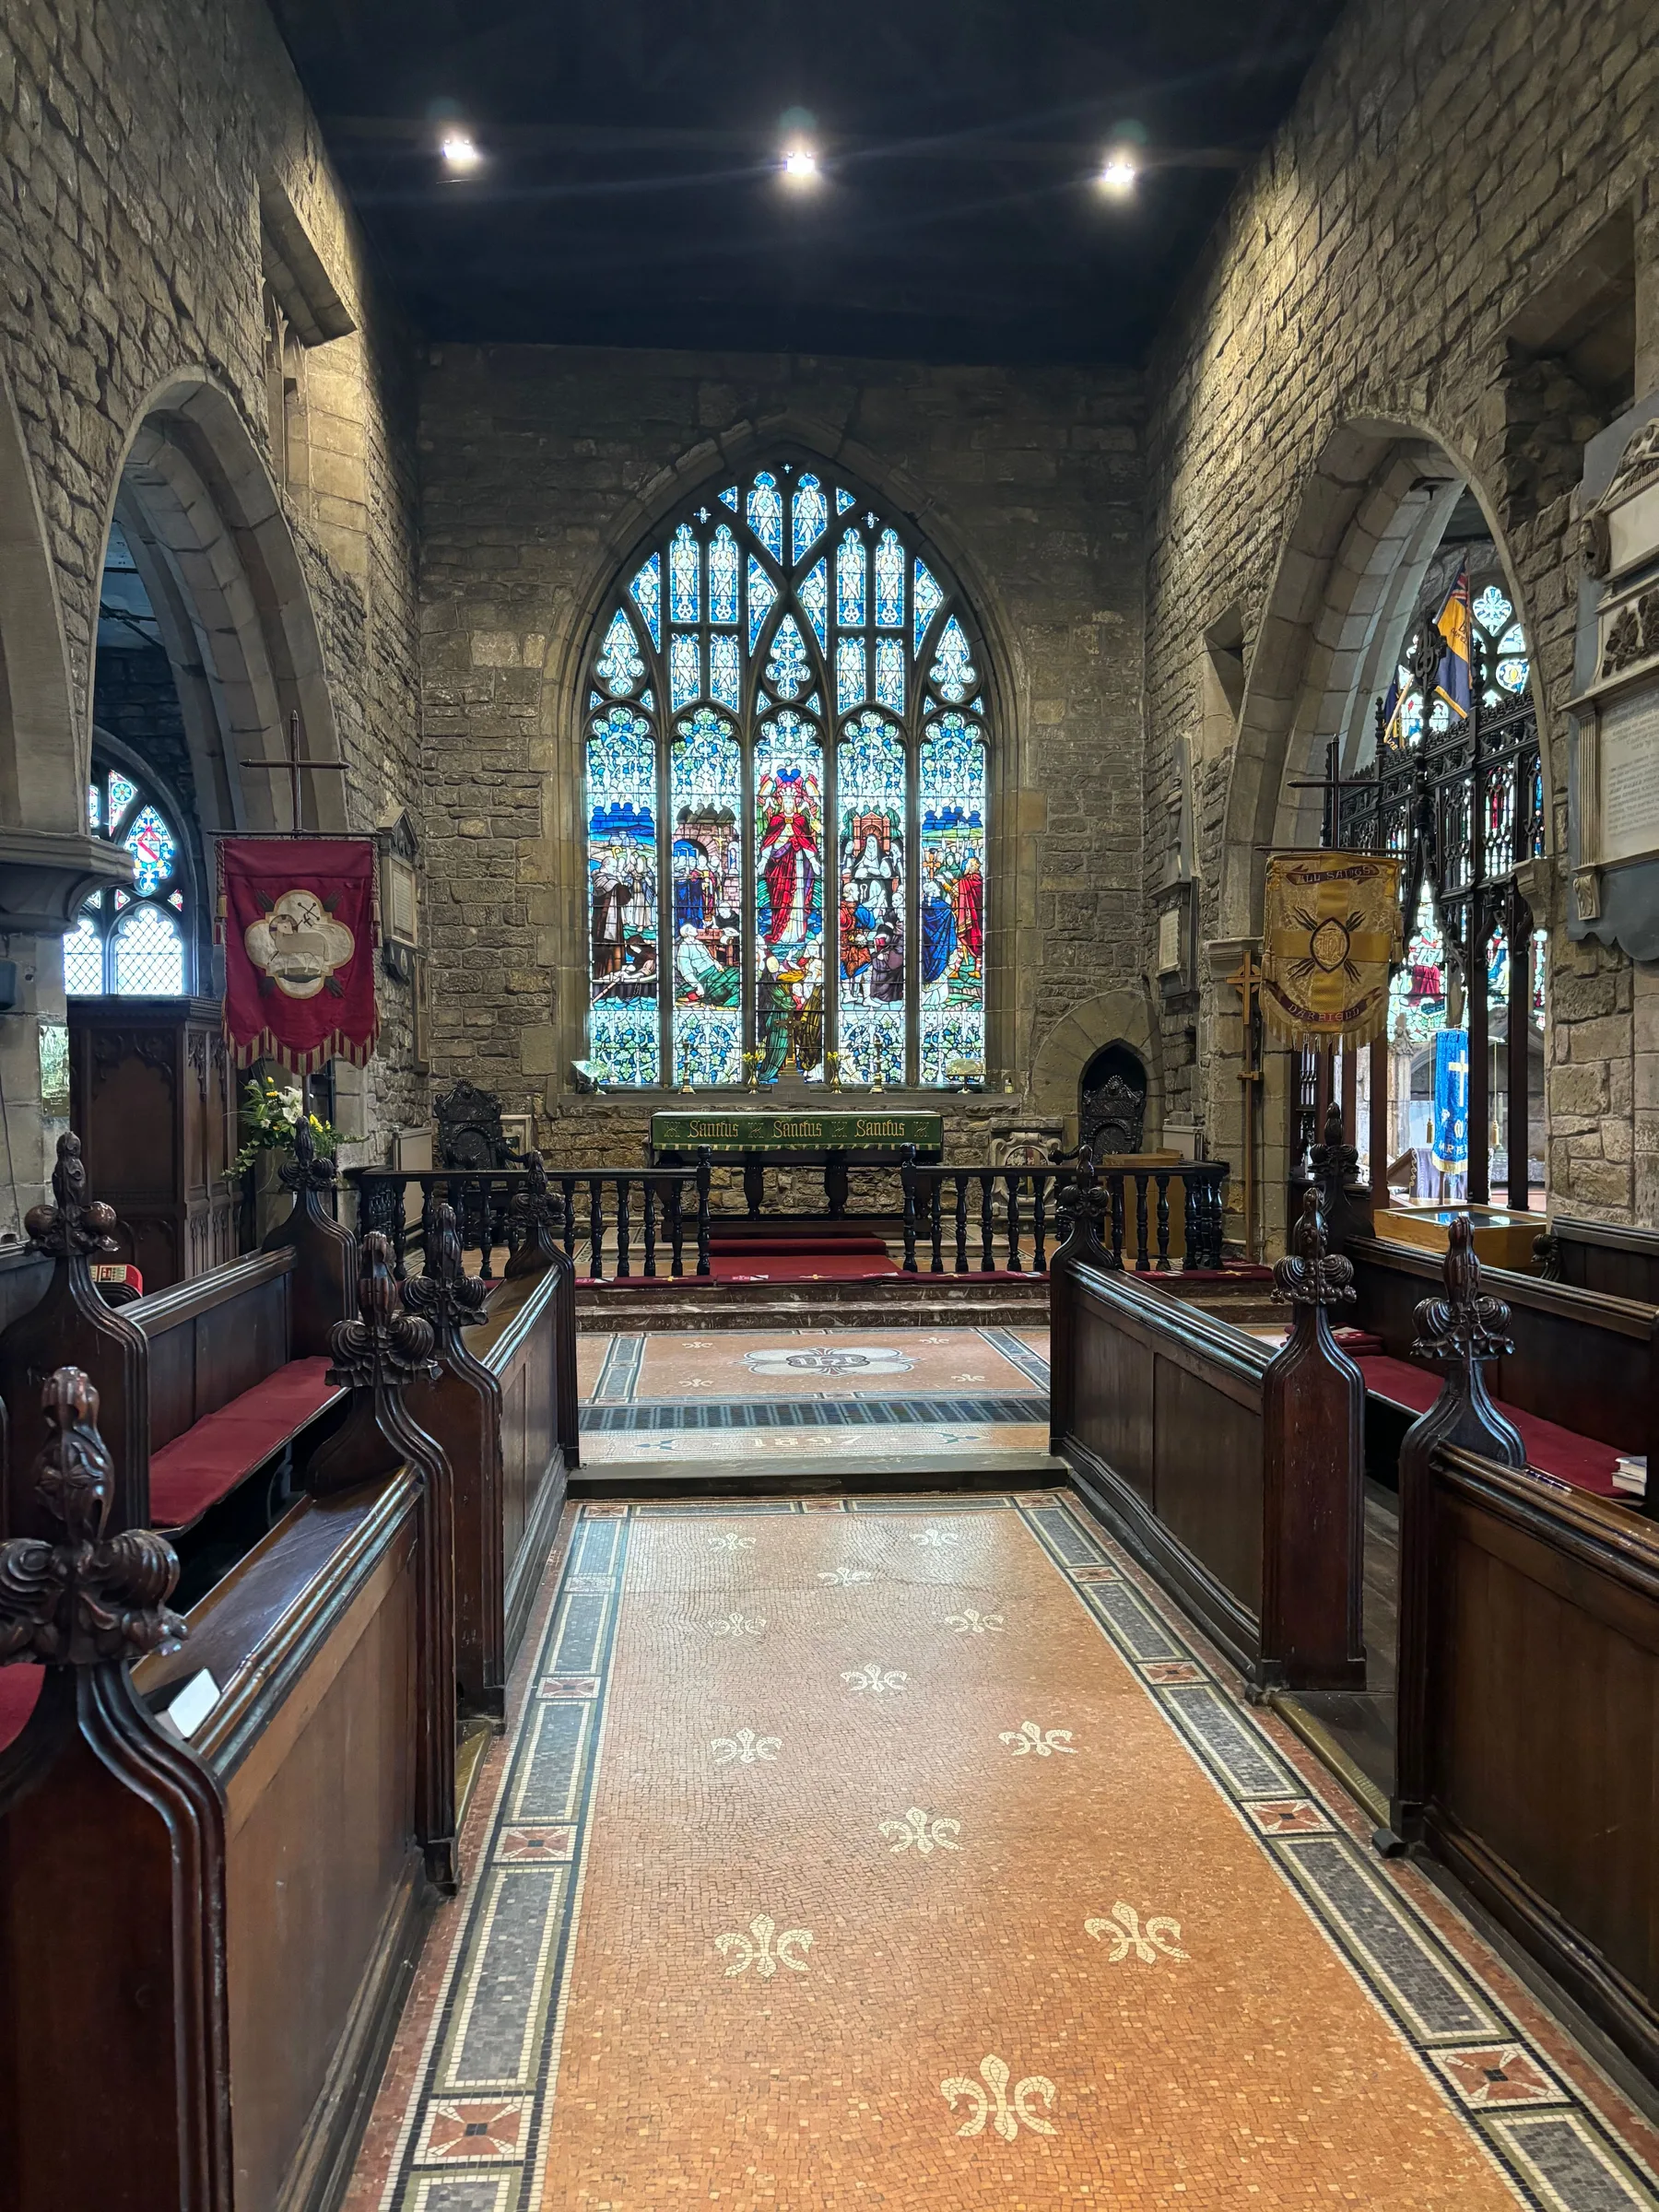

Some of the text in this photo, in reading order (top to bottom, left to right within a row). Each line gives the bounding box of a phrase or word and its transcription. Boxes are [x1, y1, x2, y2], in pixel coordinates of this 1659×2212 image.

[1288, 1004, 1359, 1022] DARFIELD
[688, 1119, 905, 1138] Sanctus Sanctus Sanctus
[751, 1435, 863, 1448] 1897
